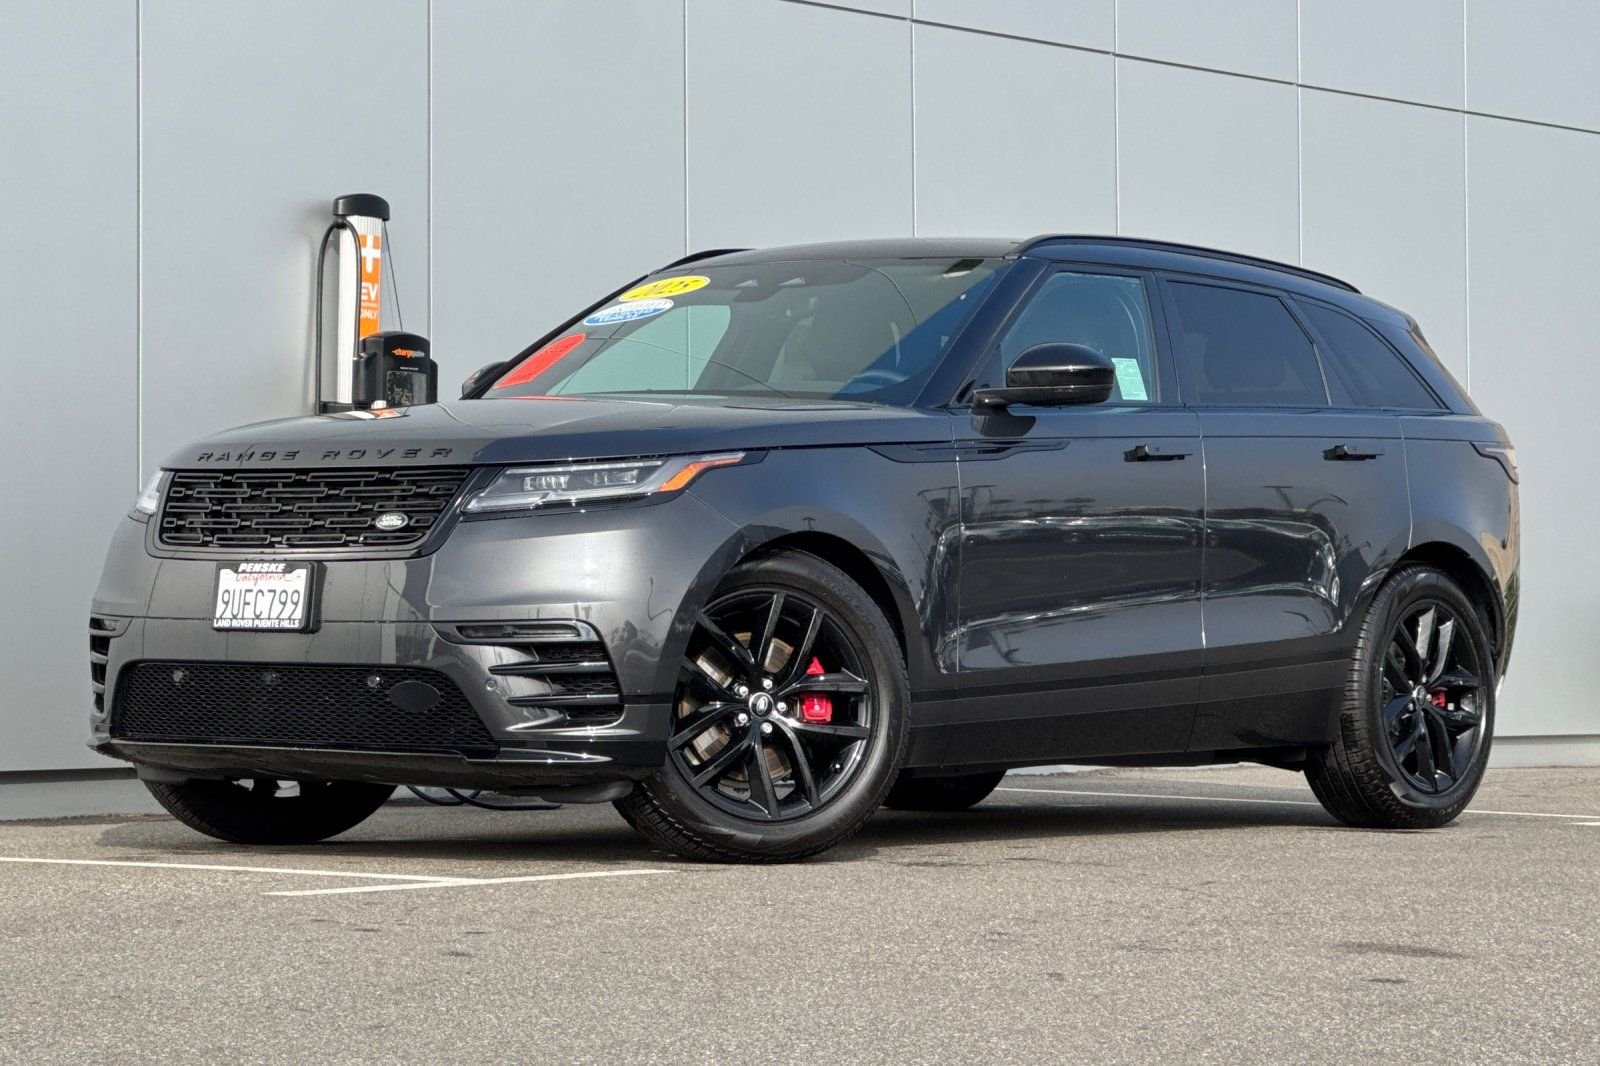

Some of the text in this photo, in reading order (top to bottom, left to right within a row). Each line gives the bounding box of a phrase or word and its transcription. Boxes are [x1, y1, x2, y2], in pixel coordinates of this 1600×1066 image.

[361, 282, 378, 301] EV
[196, 447, 453, 462] RANGE ROVER
[237, 563, 286, 572] PENSKE
[220, 589, 300, 619] 9UFC799
[213, 619, 300, 628] LAND ROVER PUENTE HILLS
